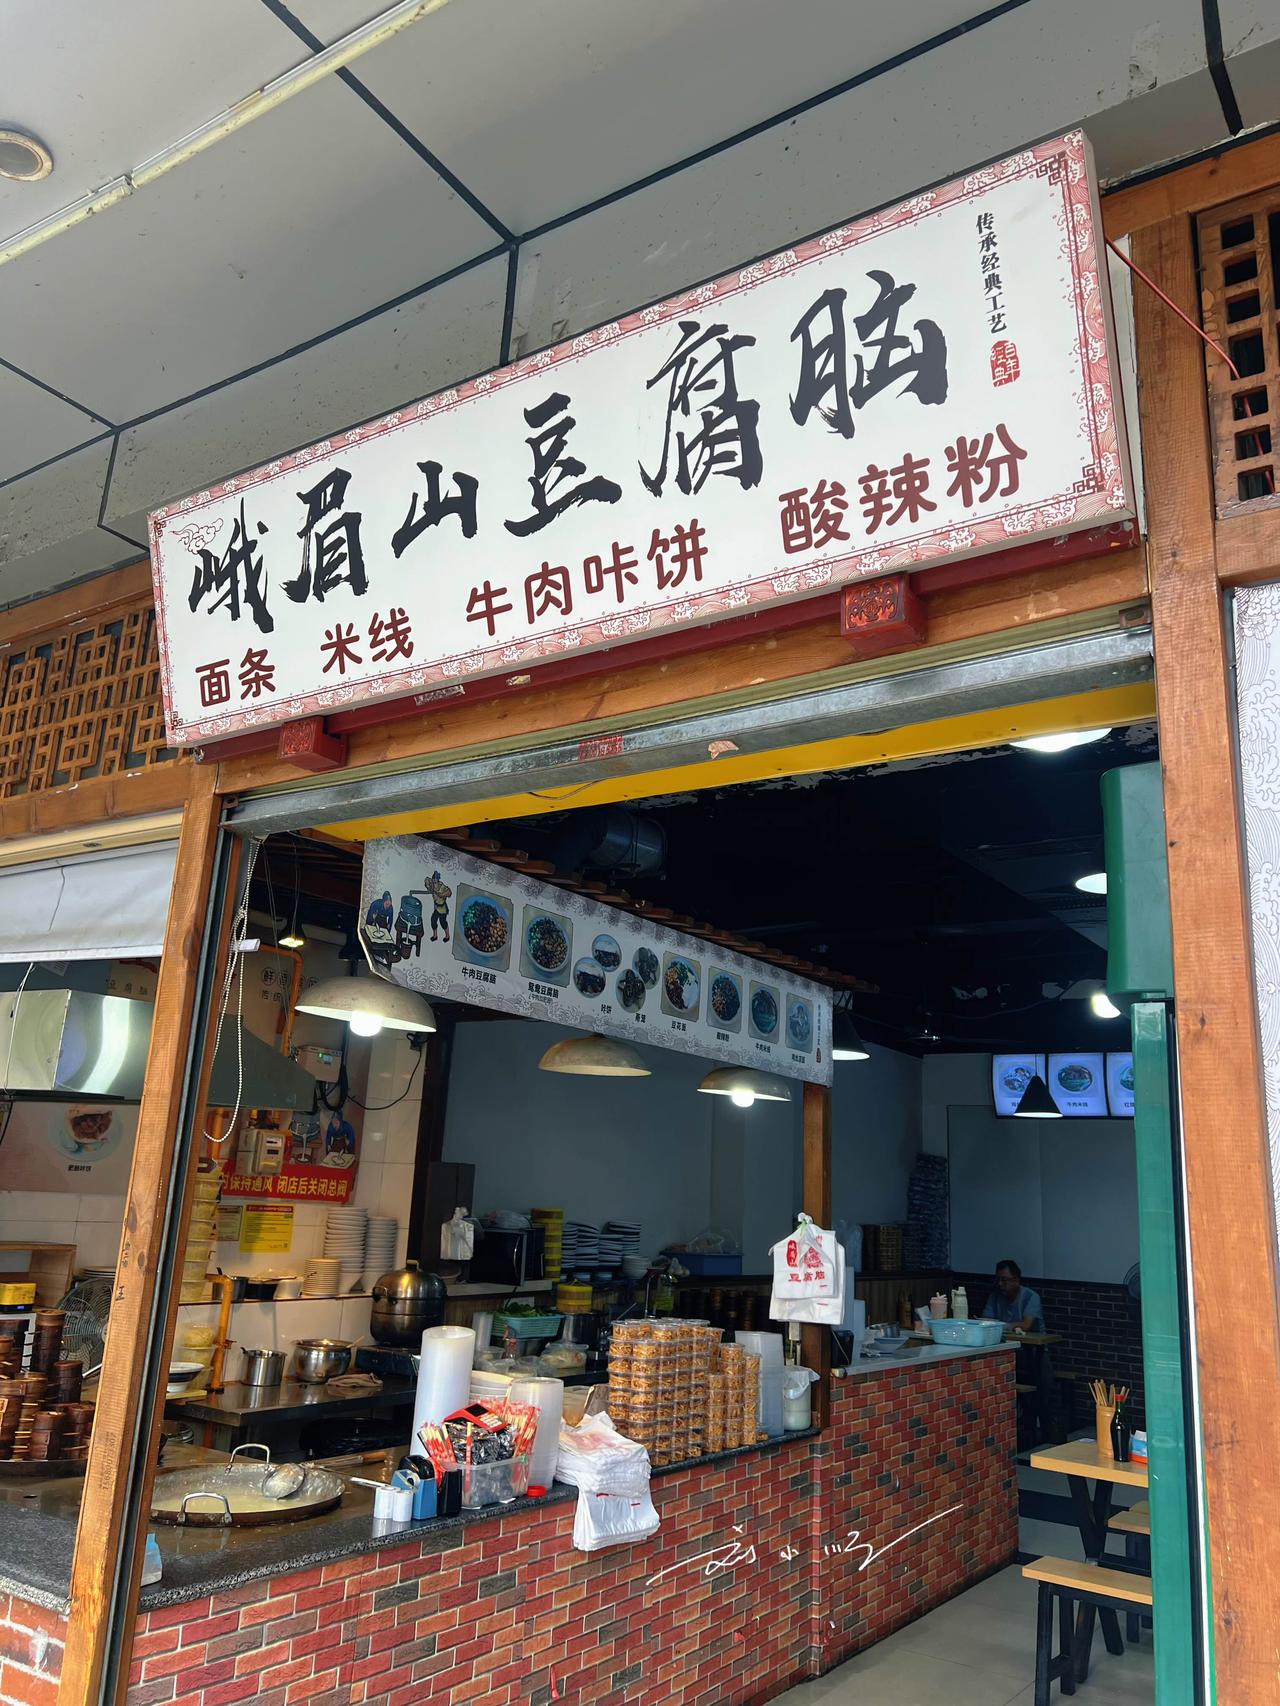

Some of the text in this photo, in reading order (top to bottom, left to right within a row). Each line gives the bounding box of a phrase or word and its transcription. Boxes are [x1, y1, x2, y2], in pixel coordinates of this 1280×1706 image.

[975, 212, 1007, 334] 传承经典工艺
[188, 269, 948, 634] 峨眉山豆腐脑
[195, 422, 1027, 709] 面条 米线 牛肉咔饼 酸辣粉
[276, 1175, 348, 1197] 闭店后关闭总阀
